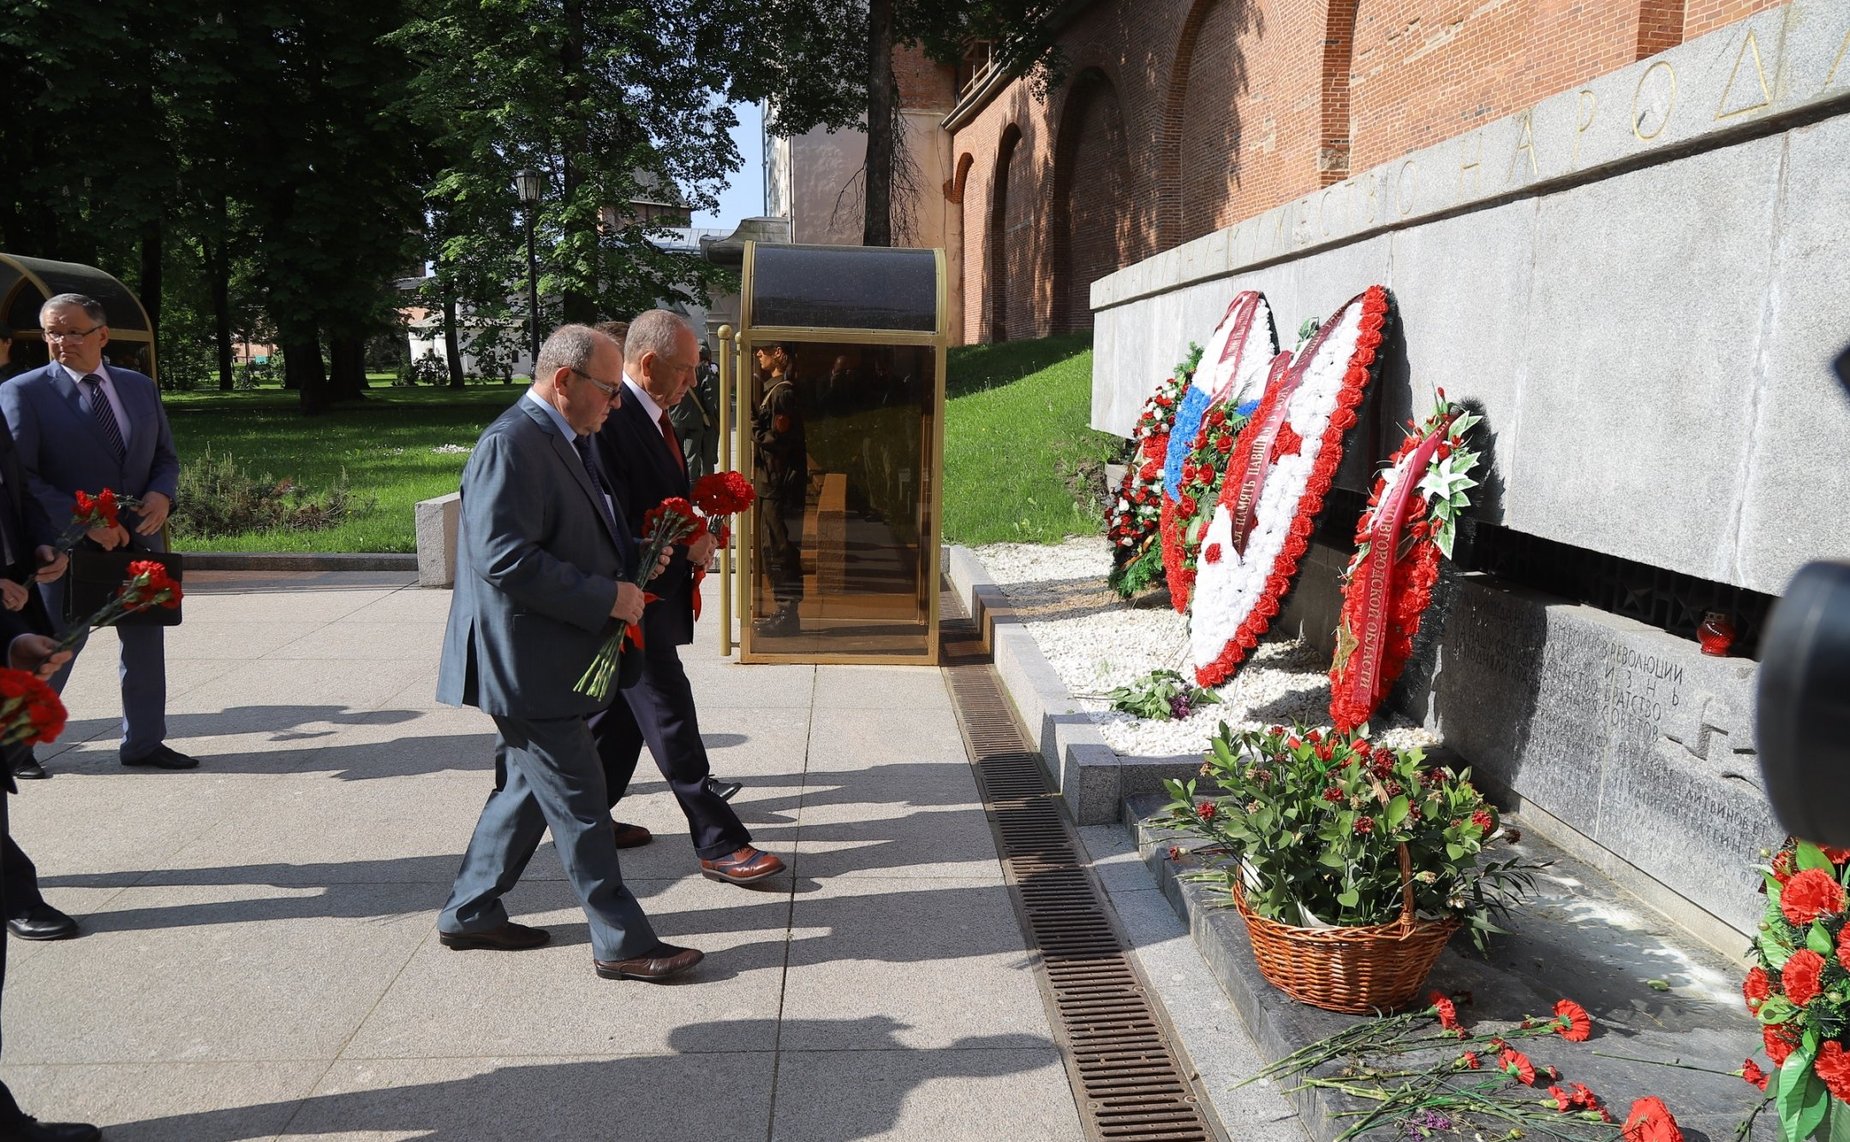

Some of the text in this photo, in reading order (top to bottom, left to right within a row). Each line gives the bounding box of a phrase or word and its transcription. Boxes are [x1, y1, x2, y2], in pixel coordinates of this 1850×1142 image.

[1236, 479, 1256, 527] ПАМЯТЬ
[1359, 503, 1397, 689] НОВГОРОДСКОЙ ОБЛАСТИ
[1610, 642, 1683, 686] РЕВОЛЮЦИИ
[1605, 683, 1662, 722] БРАТСТВО
[1602, 704, 1659, 744] СОВЕТОВ
[1684, 789, 1750, 829] ЛИТВИНОВ
